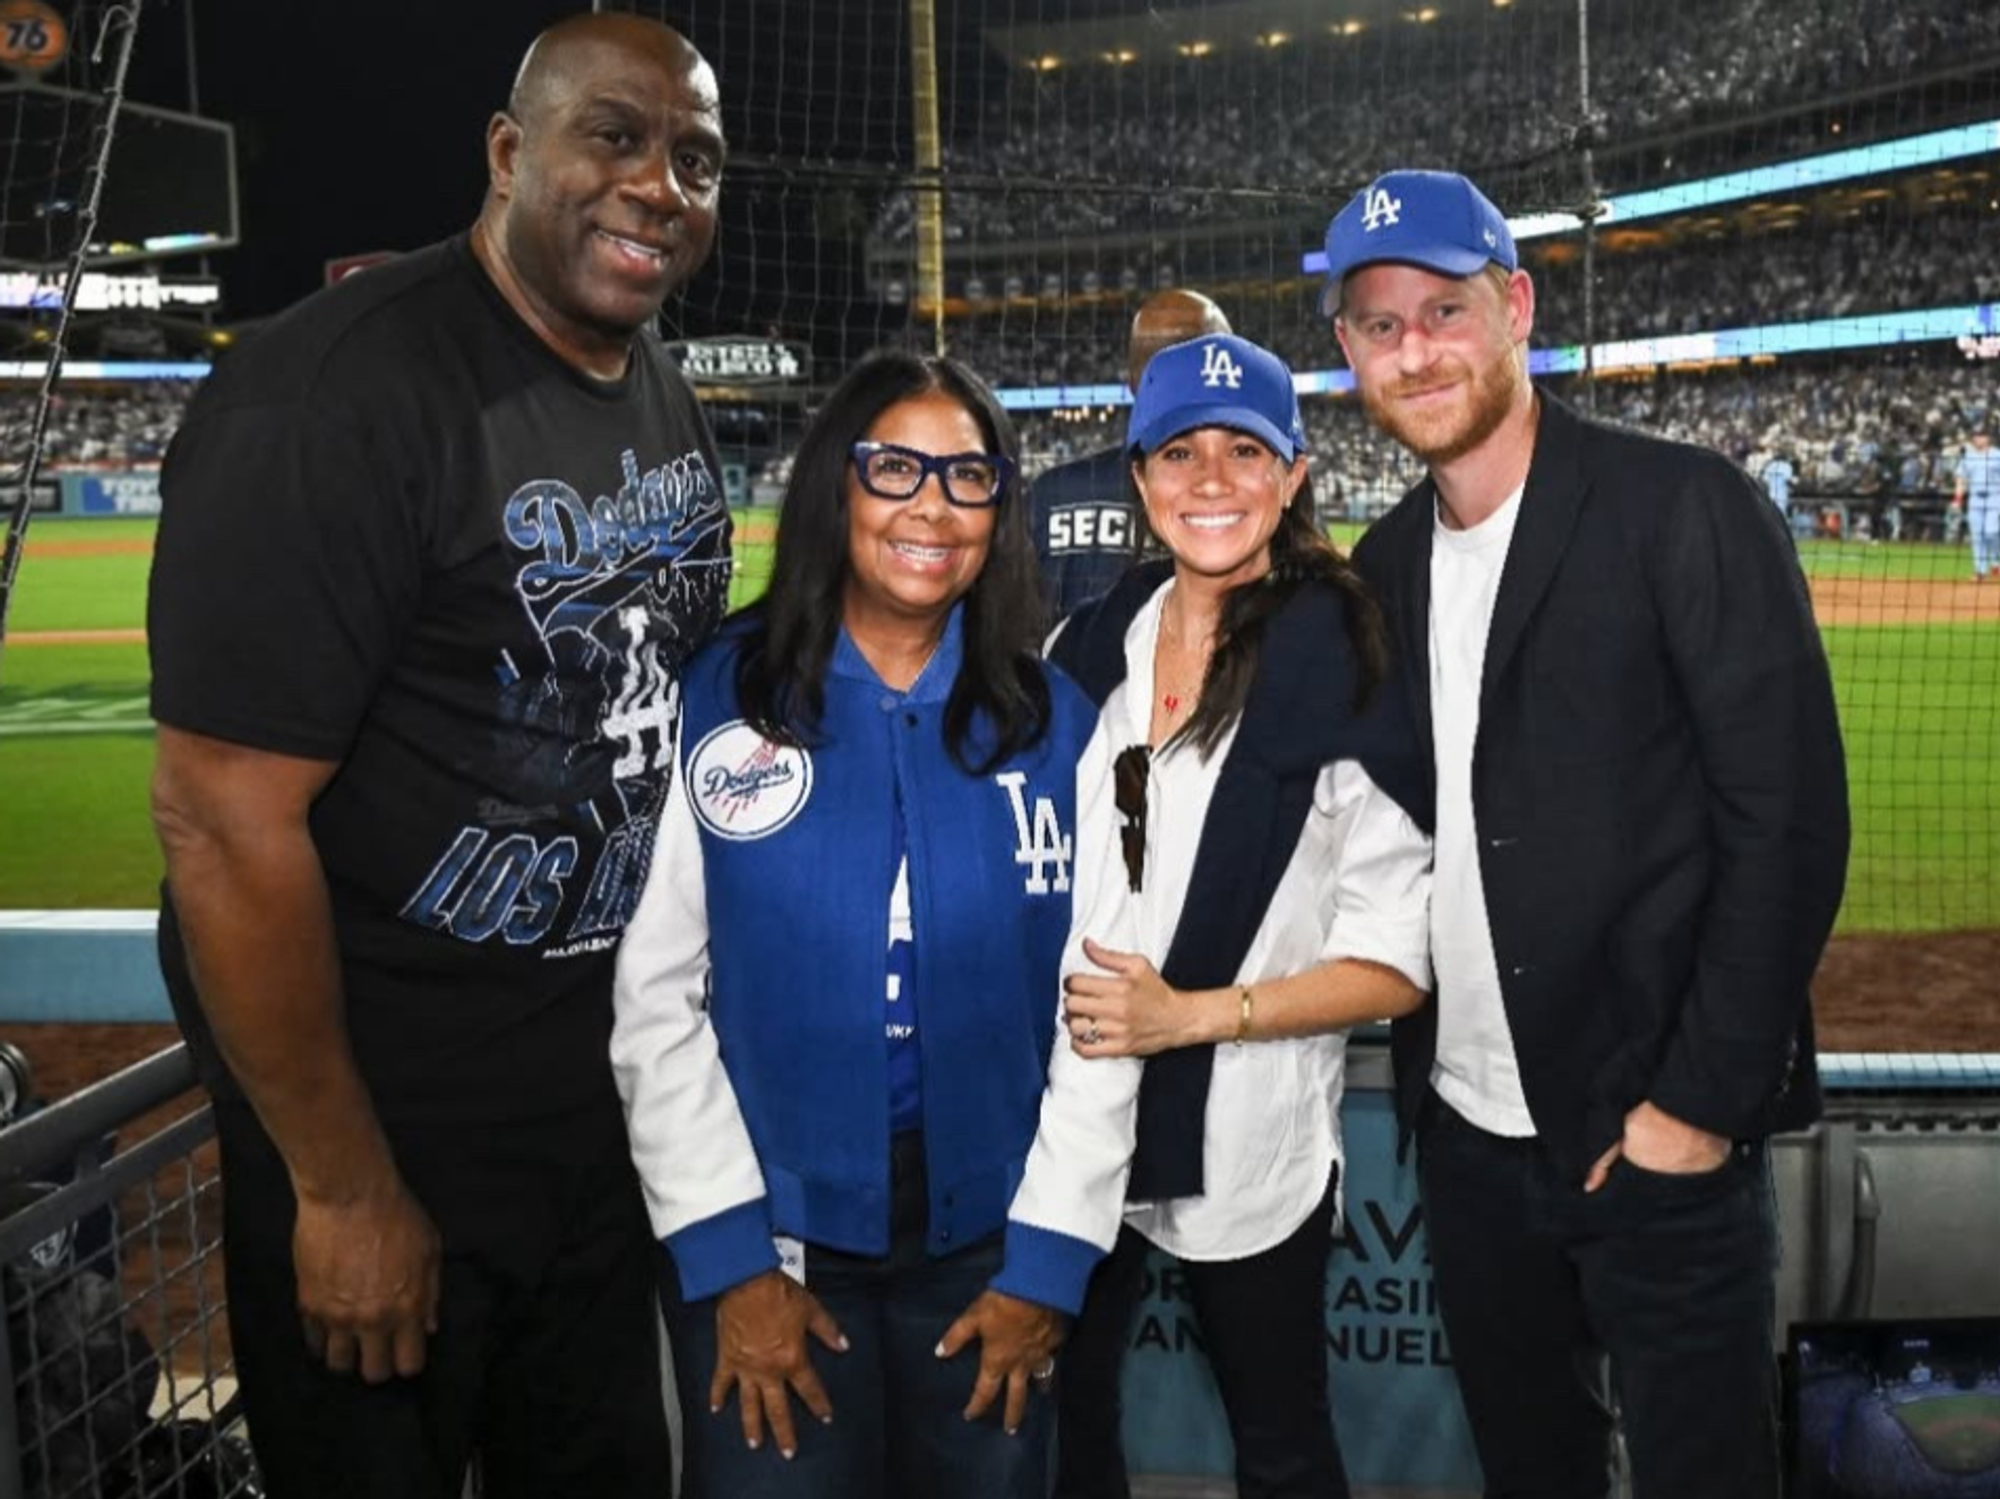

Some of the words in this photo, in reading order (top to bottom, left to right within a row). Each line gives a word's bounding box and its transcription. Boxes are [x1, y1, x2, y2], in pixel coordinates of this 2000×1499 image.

[8, 22, 48, 51] 76
[1361, 185, 1402, 232] LA
[1200, 343, 1242, 388] LA
[1049, 508, 1136, 548] SEC
[702, 760, 795, 798] Dodgers
[996, 771, 1071, 894] LA
[399, 827, 578, 944] LOS
